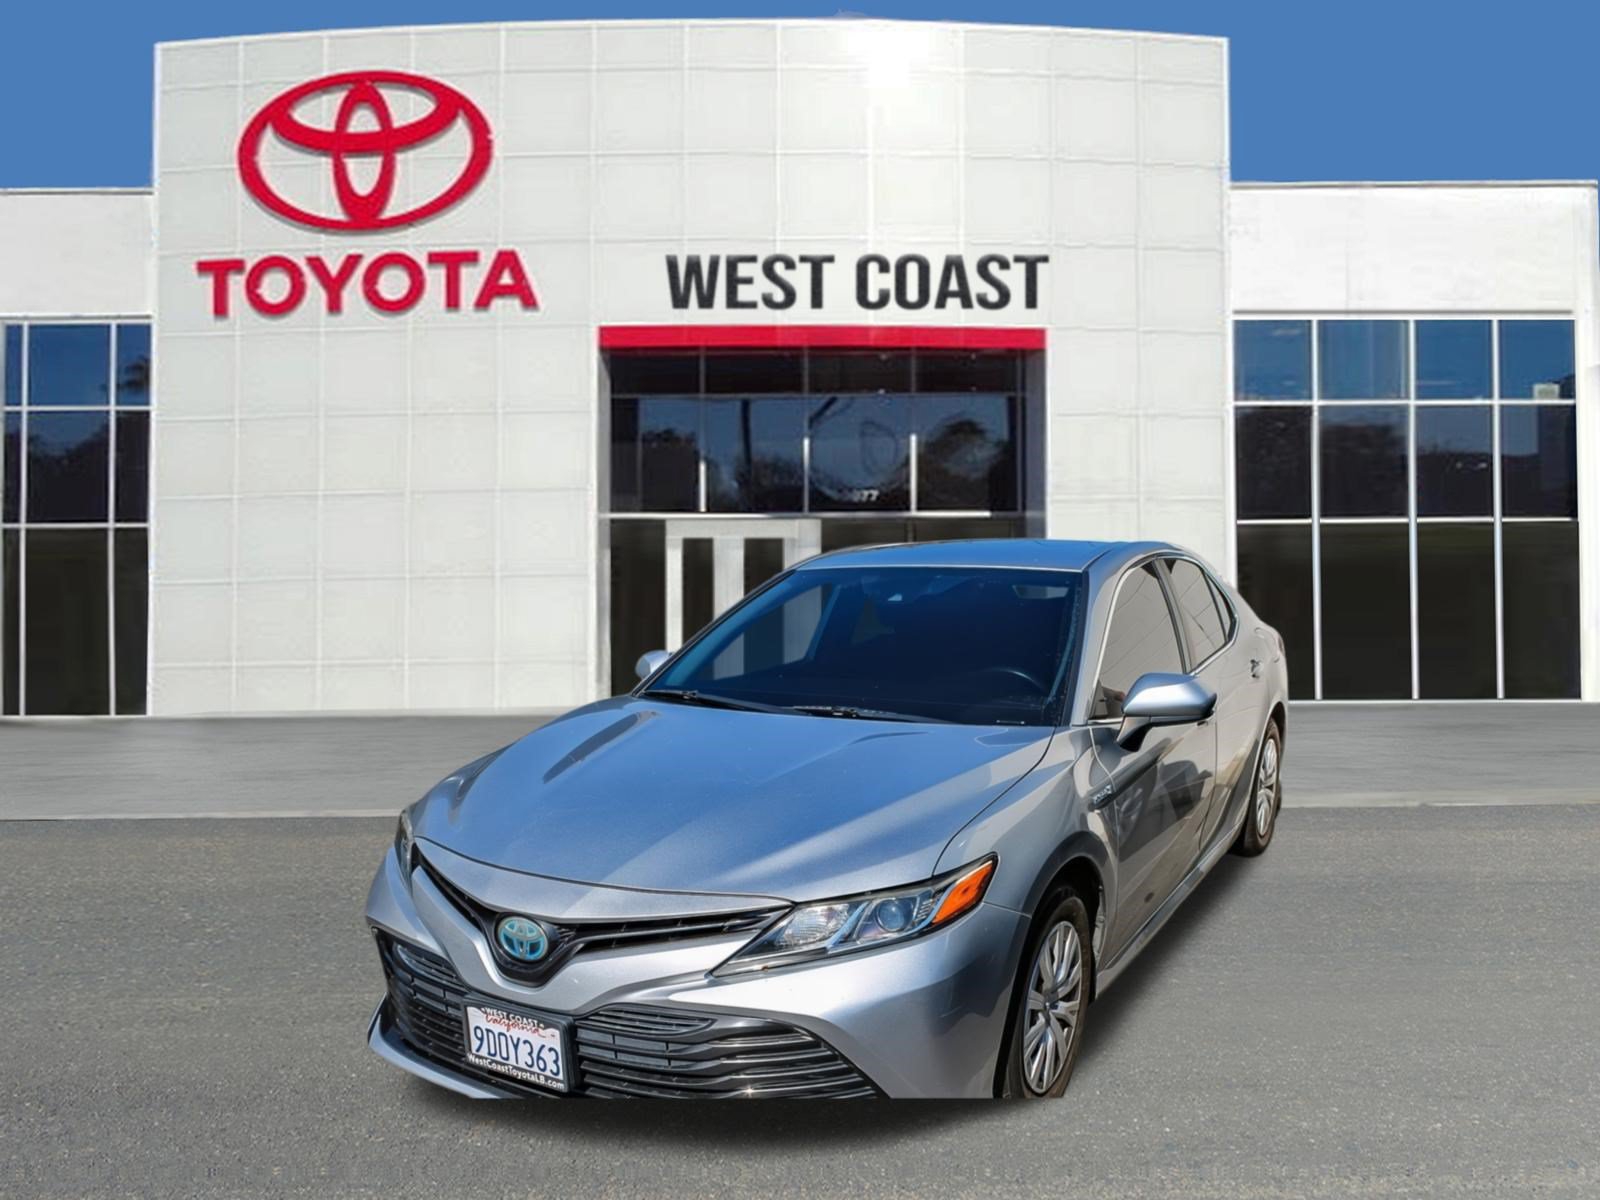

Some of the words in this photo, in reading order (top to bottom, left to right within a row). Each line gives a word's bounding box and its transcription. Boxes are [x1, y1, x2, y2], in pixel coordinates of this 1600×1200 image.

[196, 249, 539, 318] TOYOTA
[665, 254, 835, 309] WEST
[855, 254, 1050, 309] COAST
[485, 1007, 507, 1020] WEST
[509, 1014, 539, 1028] COAST
[467, 1053, 565, 1090] WestCoastToyotaLB.com
